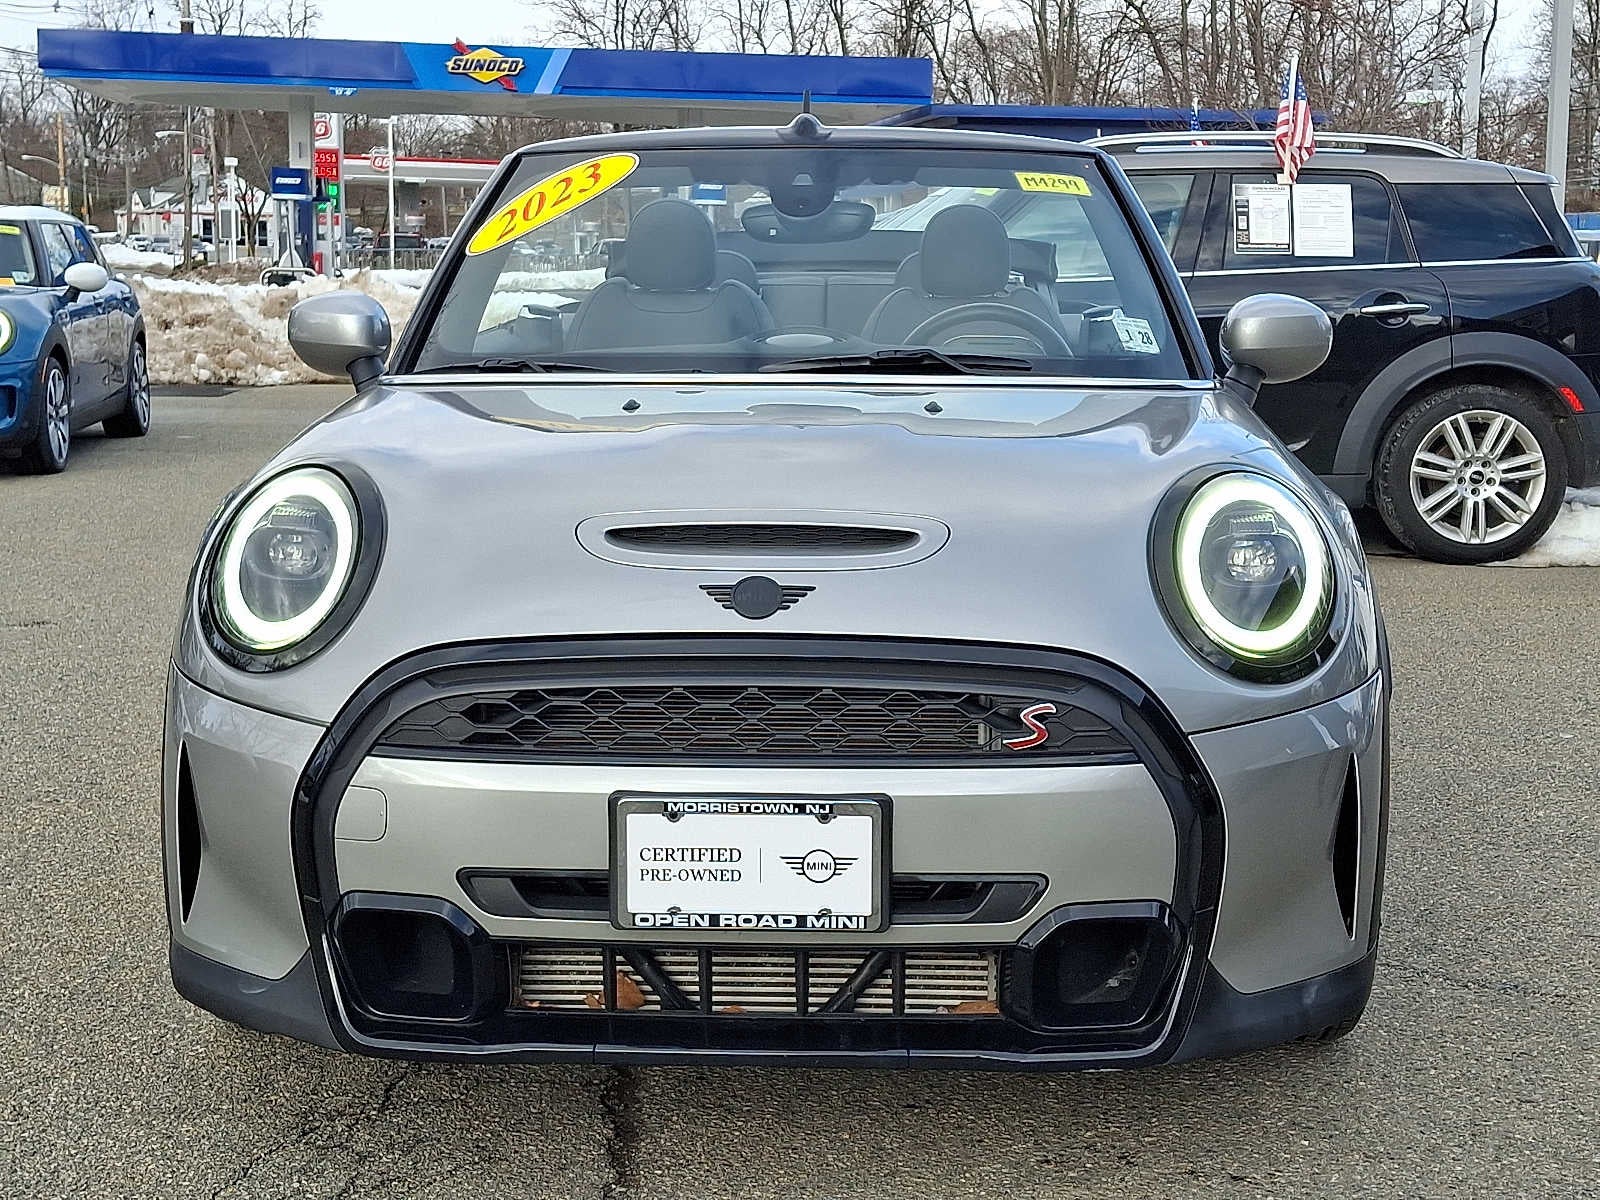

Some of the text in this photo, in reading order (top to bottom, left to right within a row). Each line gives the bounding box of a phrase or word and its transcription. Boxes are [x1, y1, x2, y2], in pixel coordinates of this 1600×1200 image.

[450, 58, 521, 73] SUNOCO
[496, 162, 601, 242] 2023
[1138, 330, 1153, 345] 28
[1002, 702, 1057, 750] S
[805, 804, 831, 815] NJ
[639, 847, 742, 863] CERTIFIED
[806, 862, 833, 872] MINI
[639, 868, 742, 882] PRE-OWNED
[634, 913, 866, 929] OPEN ROAD MINI
